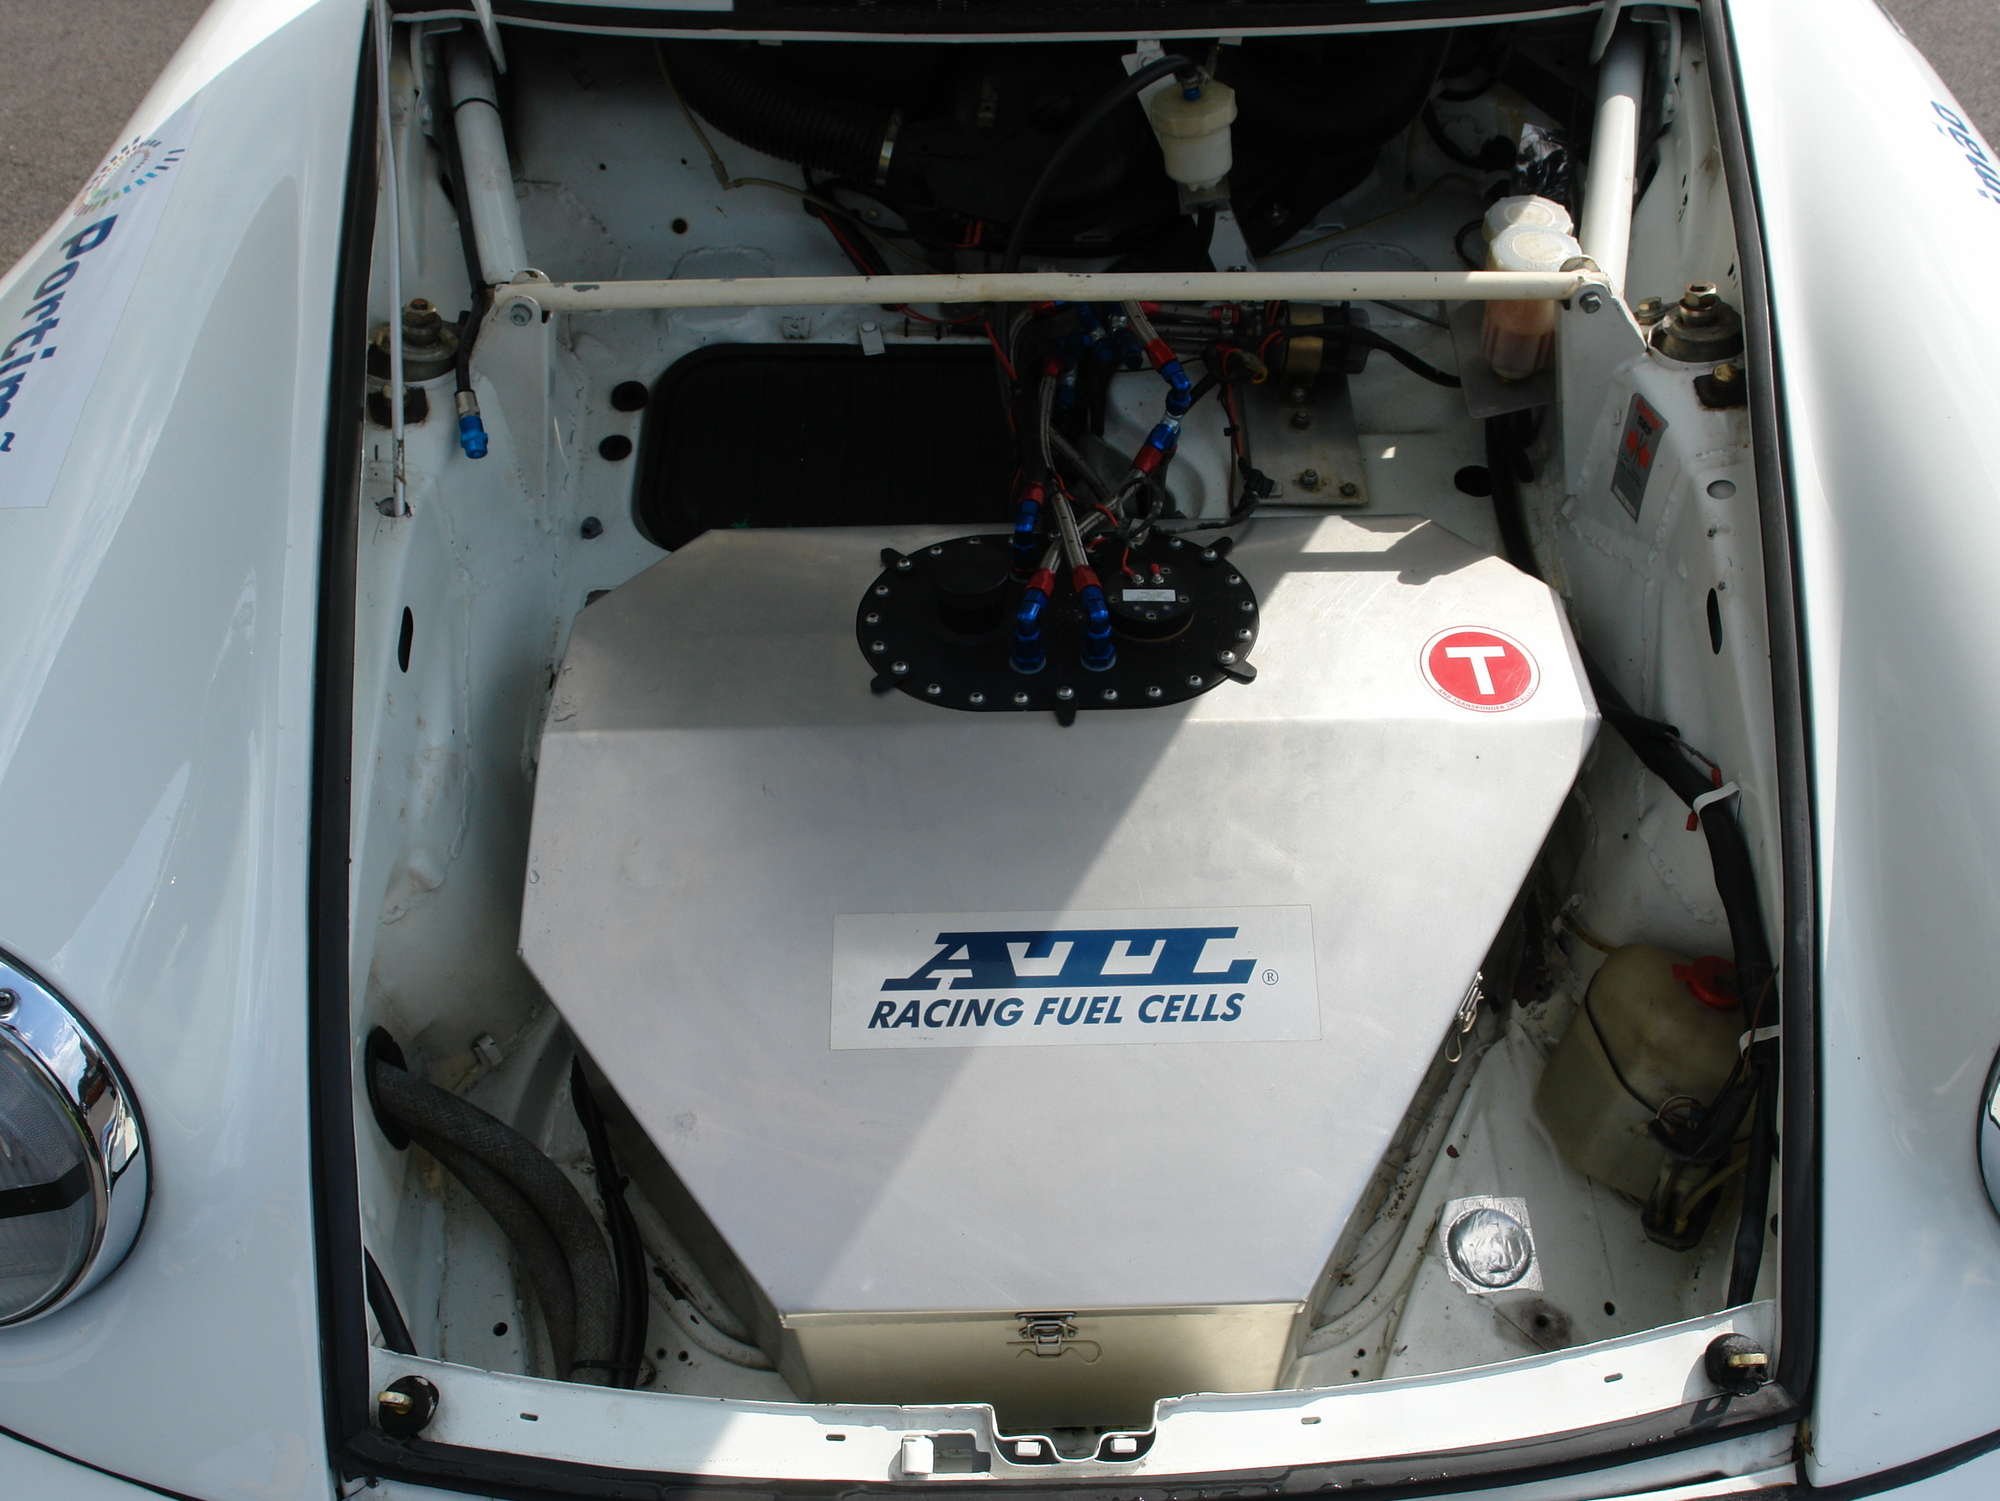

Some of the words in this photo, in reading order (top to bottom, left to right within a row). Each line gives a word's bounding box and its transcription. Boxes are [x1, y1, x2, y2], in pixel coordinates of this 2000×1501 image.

[1444, 645, 1506, 695] T
[868, 997, 1024, 1029] RACING
[1034, 994, 1124, 1026] FUEL
[1137, 992, 1247, 1023] CELLS
